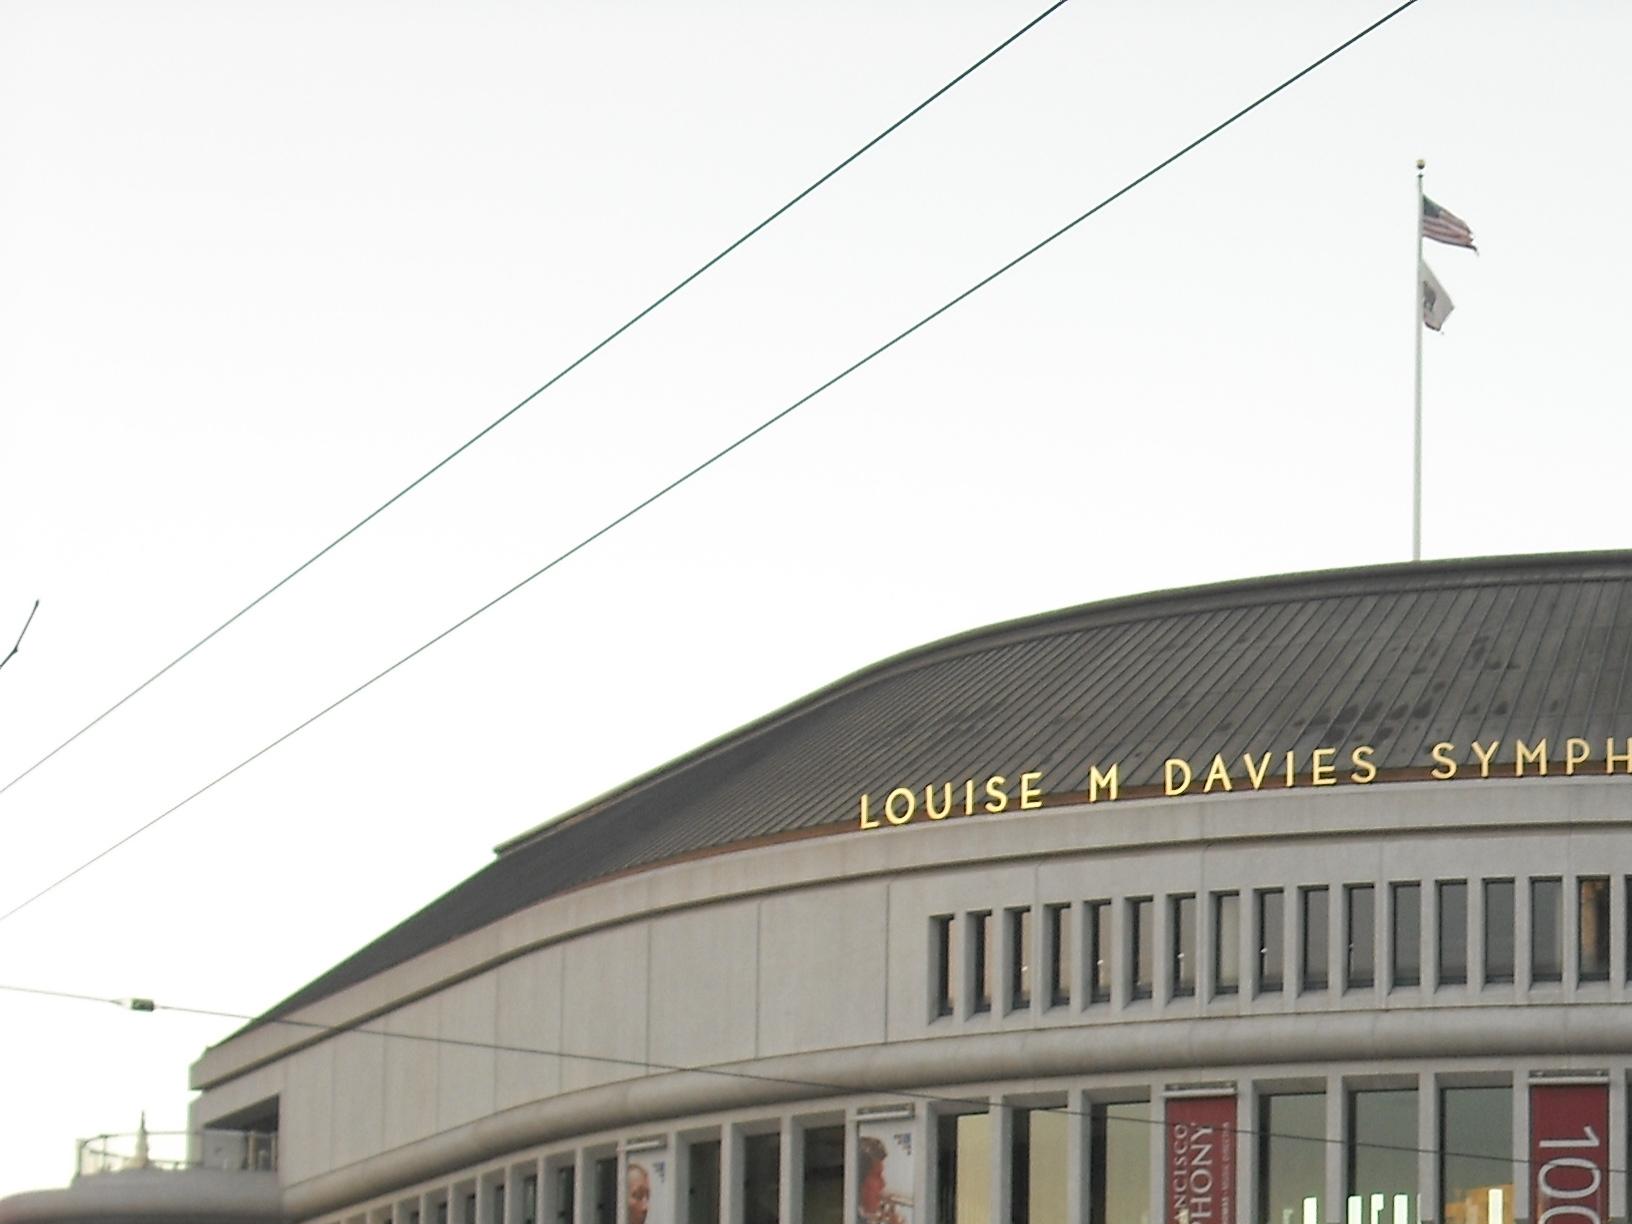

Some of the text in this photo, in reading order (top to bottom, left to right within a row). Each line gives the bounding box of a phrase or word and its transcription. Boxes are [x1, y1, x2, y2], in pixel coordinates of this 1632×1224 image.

[859, 771, 1043, 830] LOUISE
[1088, 763, 1119, 803] M
[1163, 746, 1378, 797] DAVIES
